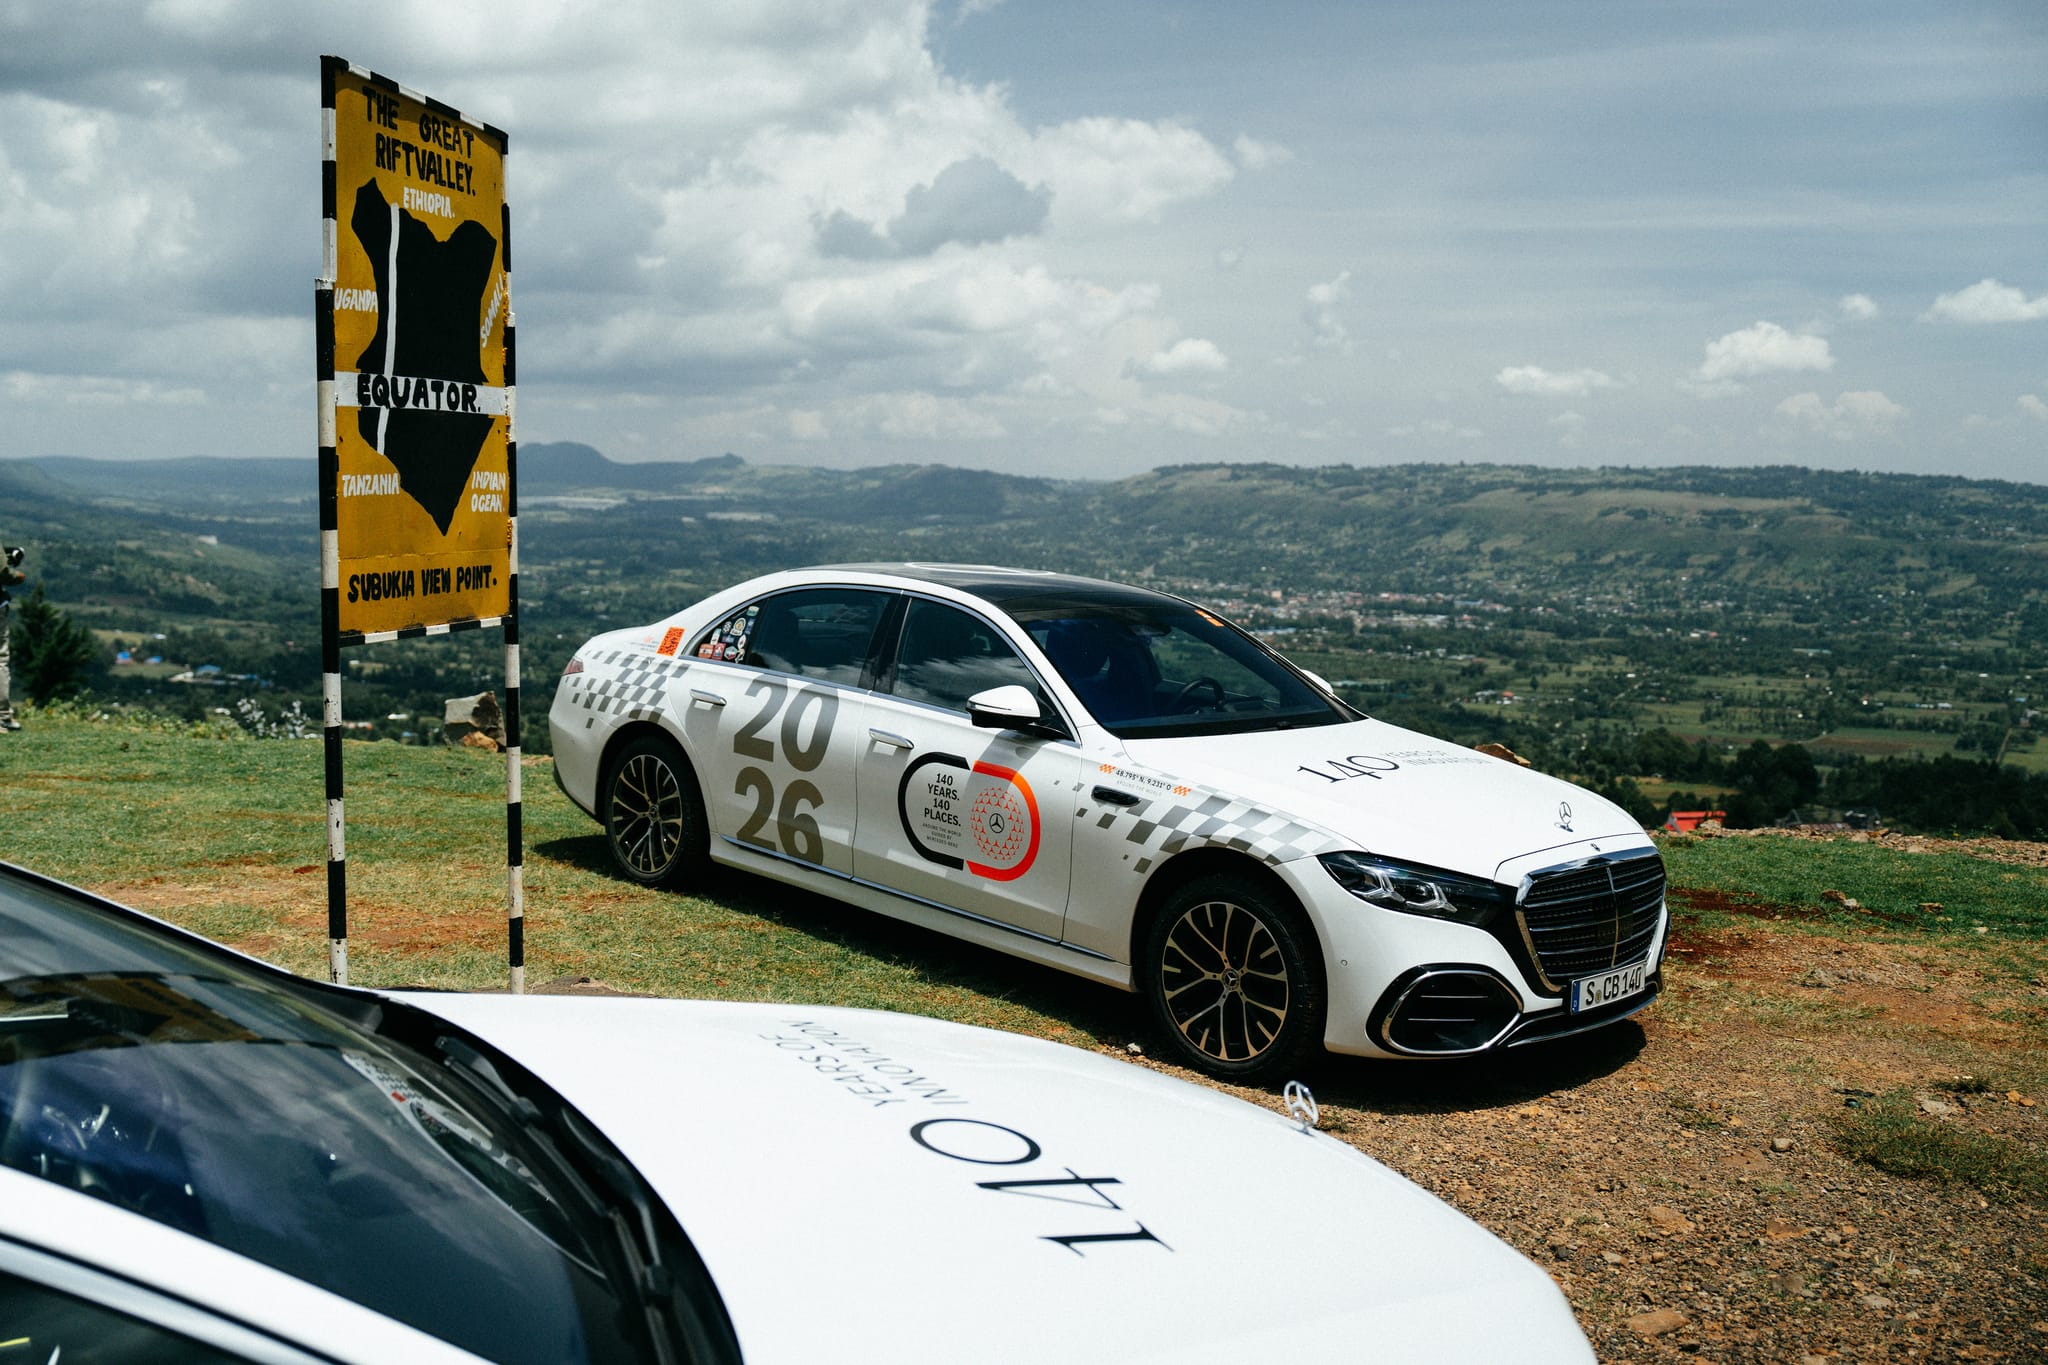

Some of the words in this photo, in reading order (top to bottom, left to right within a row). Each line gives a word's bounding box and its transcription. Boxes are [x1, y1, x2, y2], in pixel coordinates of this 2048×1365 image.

[362, 86, 399, 131] THE
[419, 112, 475, 159] GREAT
[403, 187, 455, 219] ETHIOPIA.
[334, 288, 378, 313] UGANDA
[357, 373, 481, 413] EQUATOR.
[342, 473, 400, 497] TANZANIA
[471, 471, 506, 491] INDIAN
[347, 570, 415, 603] SUBUKIA
[421, 567, 451, 596] VIEW
[456, 564, 498, 593] POINT.
[733, 673, 840, 772] 20
[936, 773, 954, 786] 140
[1297, 755, 1400, 783] 140
[927, 783, 960, 801] YEARS.
[933, 798, 951, 811] 140
[735, 766, 825, 867] 26
[924, 807, 962, 827] PLACES.
[1586, 981, 1595, 1006] S
[1603, 974, 1620, 1000] CB
[1621, 966, 1642, 995] 140
[799, 1055, 907, 1107] YEARS
[909, 1118, 1175, 1258] 140
